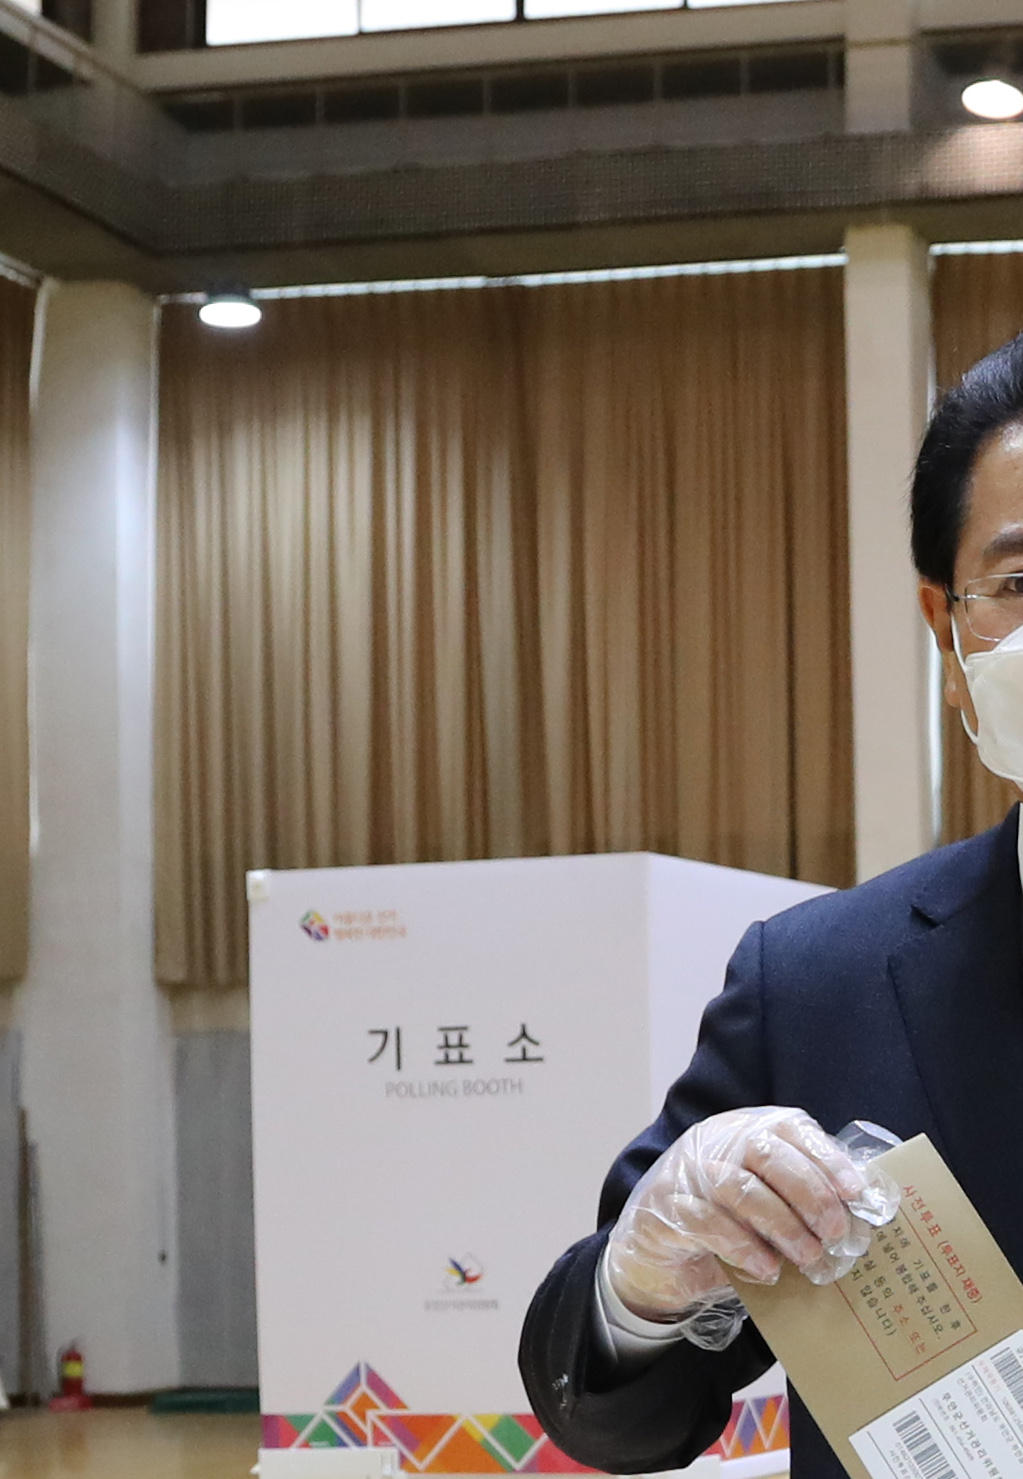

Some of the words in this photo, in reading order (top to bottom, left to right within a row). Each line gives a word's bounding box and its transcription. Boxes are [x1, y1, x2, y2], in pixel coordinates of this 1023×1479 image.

[385, 1079, 457, 1098] POLLING
[462, 1077, 524, 1096] BOOTH
[901, 1183, 943, 1237] 사전투표
[935, 1239, 967, 1277] (투표지
[959, 1276, 983, 1304] 재중)
[858, 1284, 898, 1337] 않습니다)
[873, 1274, 894, 1299] 등의
[891, 1302, 910, 1326] 주소
[906, 1330, 928, 1355] 또는
[882, 1241, 901, 1263] 넣어
[894, 1263, 919, 1294] 봉합해
[913, 1294, 947, 1340] 주십시오.
[911, 1258, 939, 1293] 기표를
[939, 1302, 952, 1314] 한
[947, 1318, 961, 1332] 후
